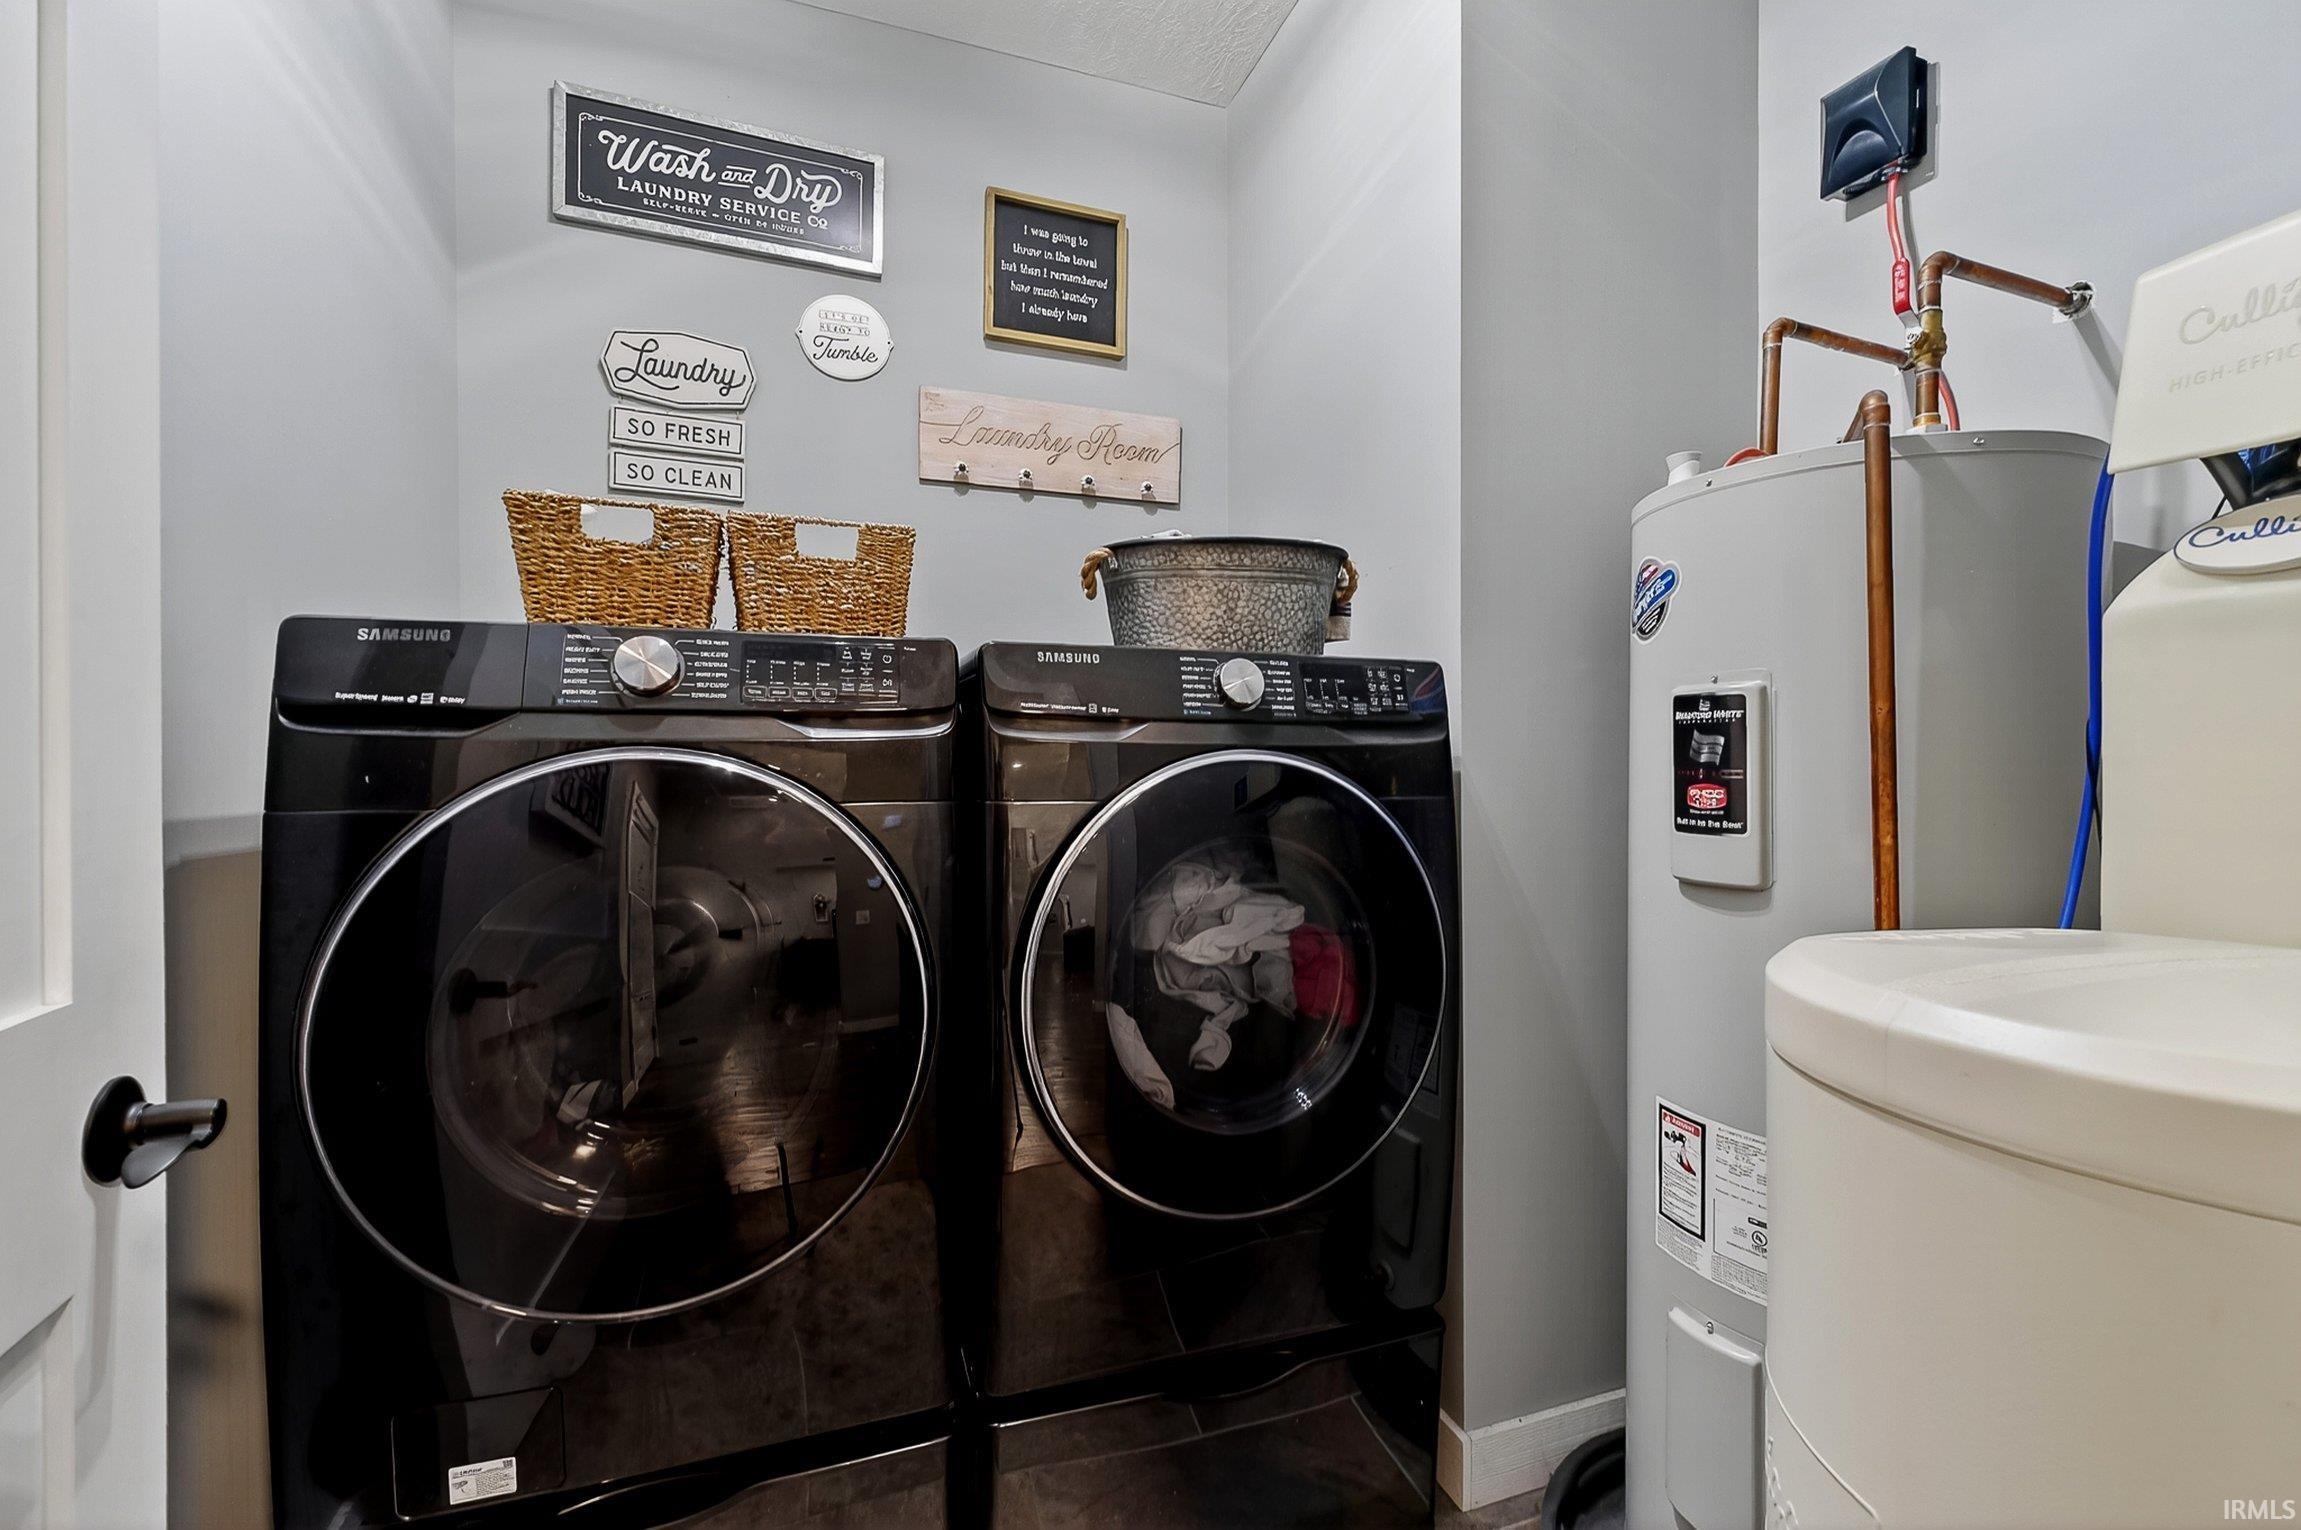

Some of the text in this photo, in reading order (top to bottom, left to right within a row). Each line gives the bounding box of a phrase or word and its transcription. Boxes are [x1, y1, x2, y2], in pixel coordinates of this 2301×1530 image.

[598, 129, 843, 212] Wash and Dry
[617, 176, 713, 208] LAUNDRY
[719, 197, 801, 224] SERVICE
[1023, 224, 1089, 248] I was going to
[1012, 242, 1098, 269] throw in the towel
[1001, 259, 1108, 290] but then I remembered
[1010, 280, 1099, 309] how much laundry
[1021, 302, 1088, 323] I already have
[2178, 276, 2301, 345] Culli
[813, 335, 879, 363] Tumble
[614, 338, 747, 397] Laundry
[626, 417, 730, 447] SO FRESH
[922, 405, 1180, 466] Laundry Room
[626, 463, 732, 490] SO CLEAN
[2188, 515, 2301, 548] Culli
[356, 627, 451, 642] SAMSUNG
[1037, 651, 1100, 664] SAMSUNG
